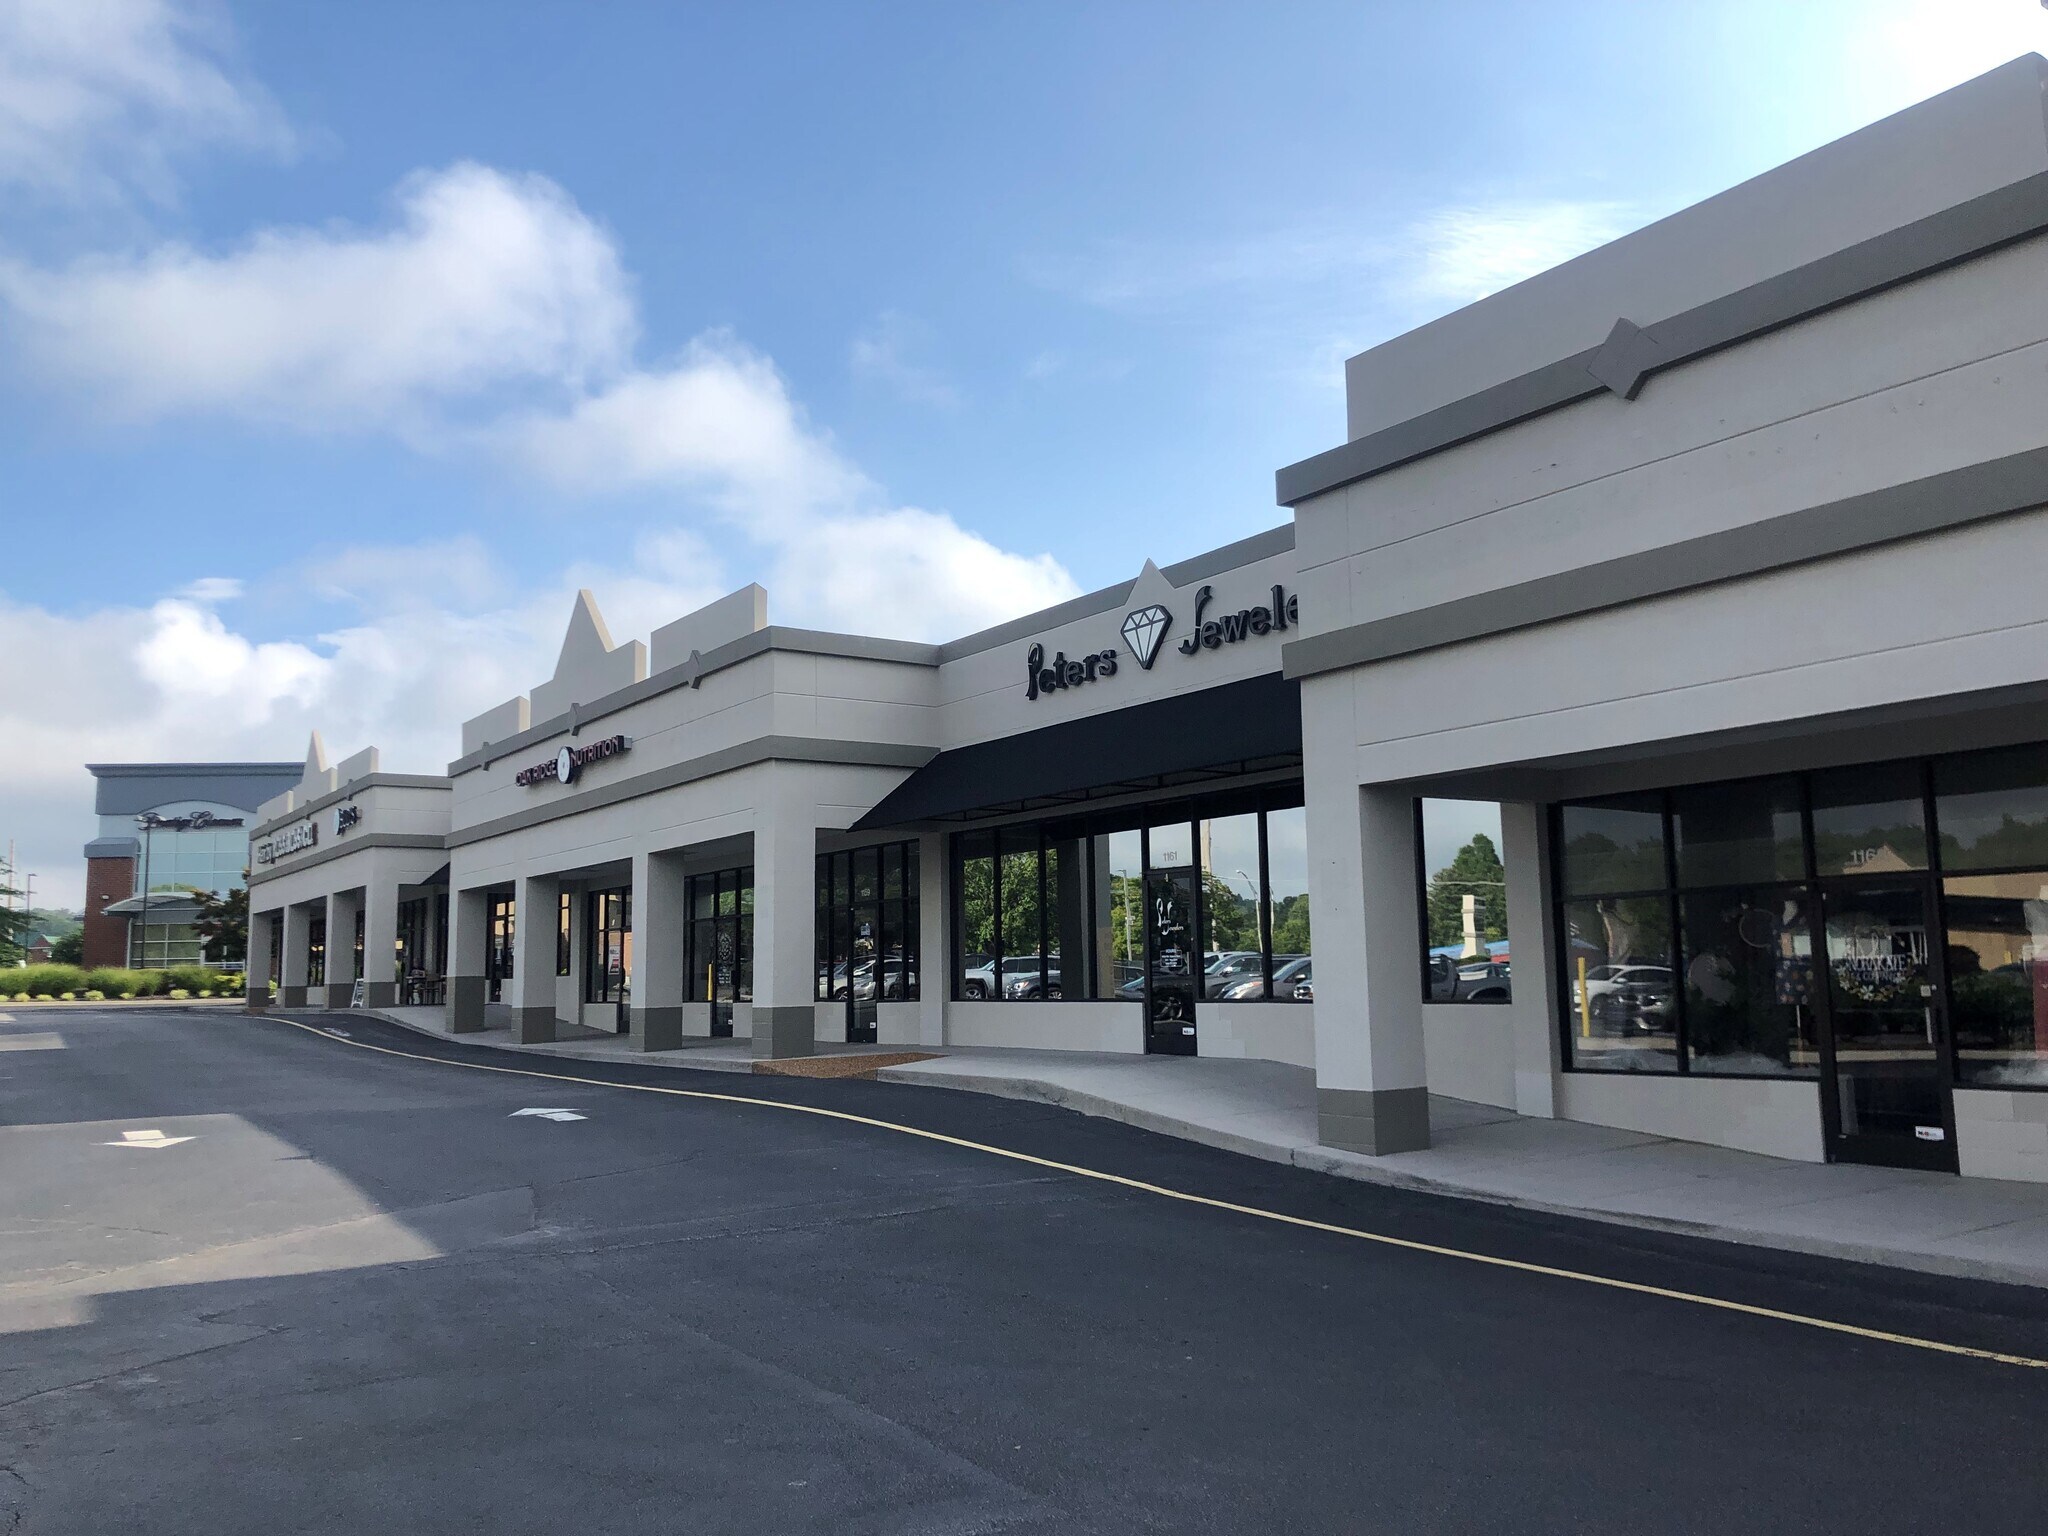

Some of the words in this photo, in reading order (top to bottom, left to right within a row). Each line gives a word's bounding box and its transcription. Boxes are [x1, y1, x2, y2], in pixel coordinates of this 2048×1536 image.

[1025, 642, 1118, 701] Peters
[532, 759, 558, 781] RIDGE
[570, 735, 624, 767] NUTRITION
[1163, 850, 1178, 862] 1161
